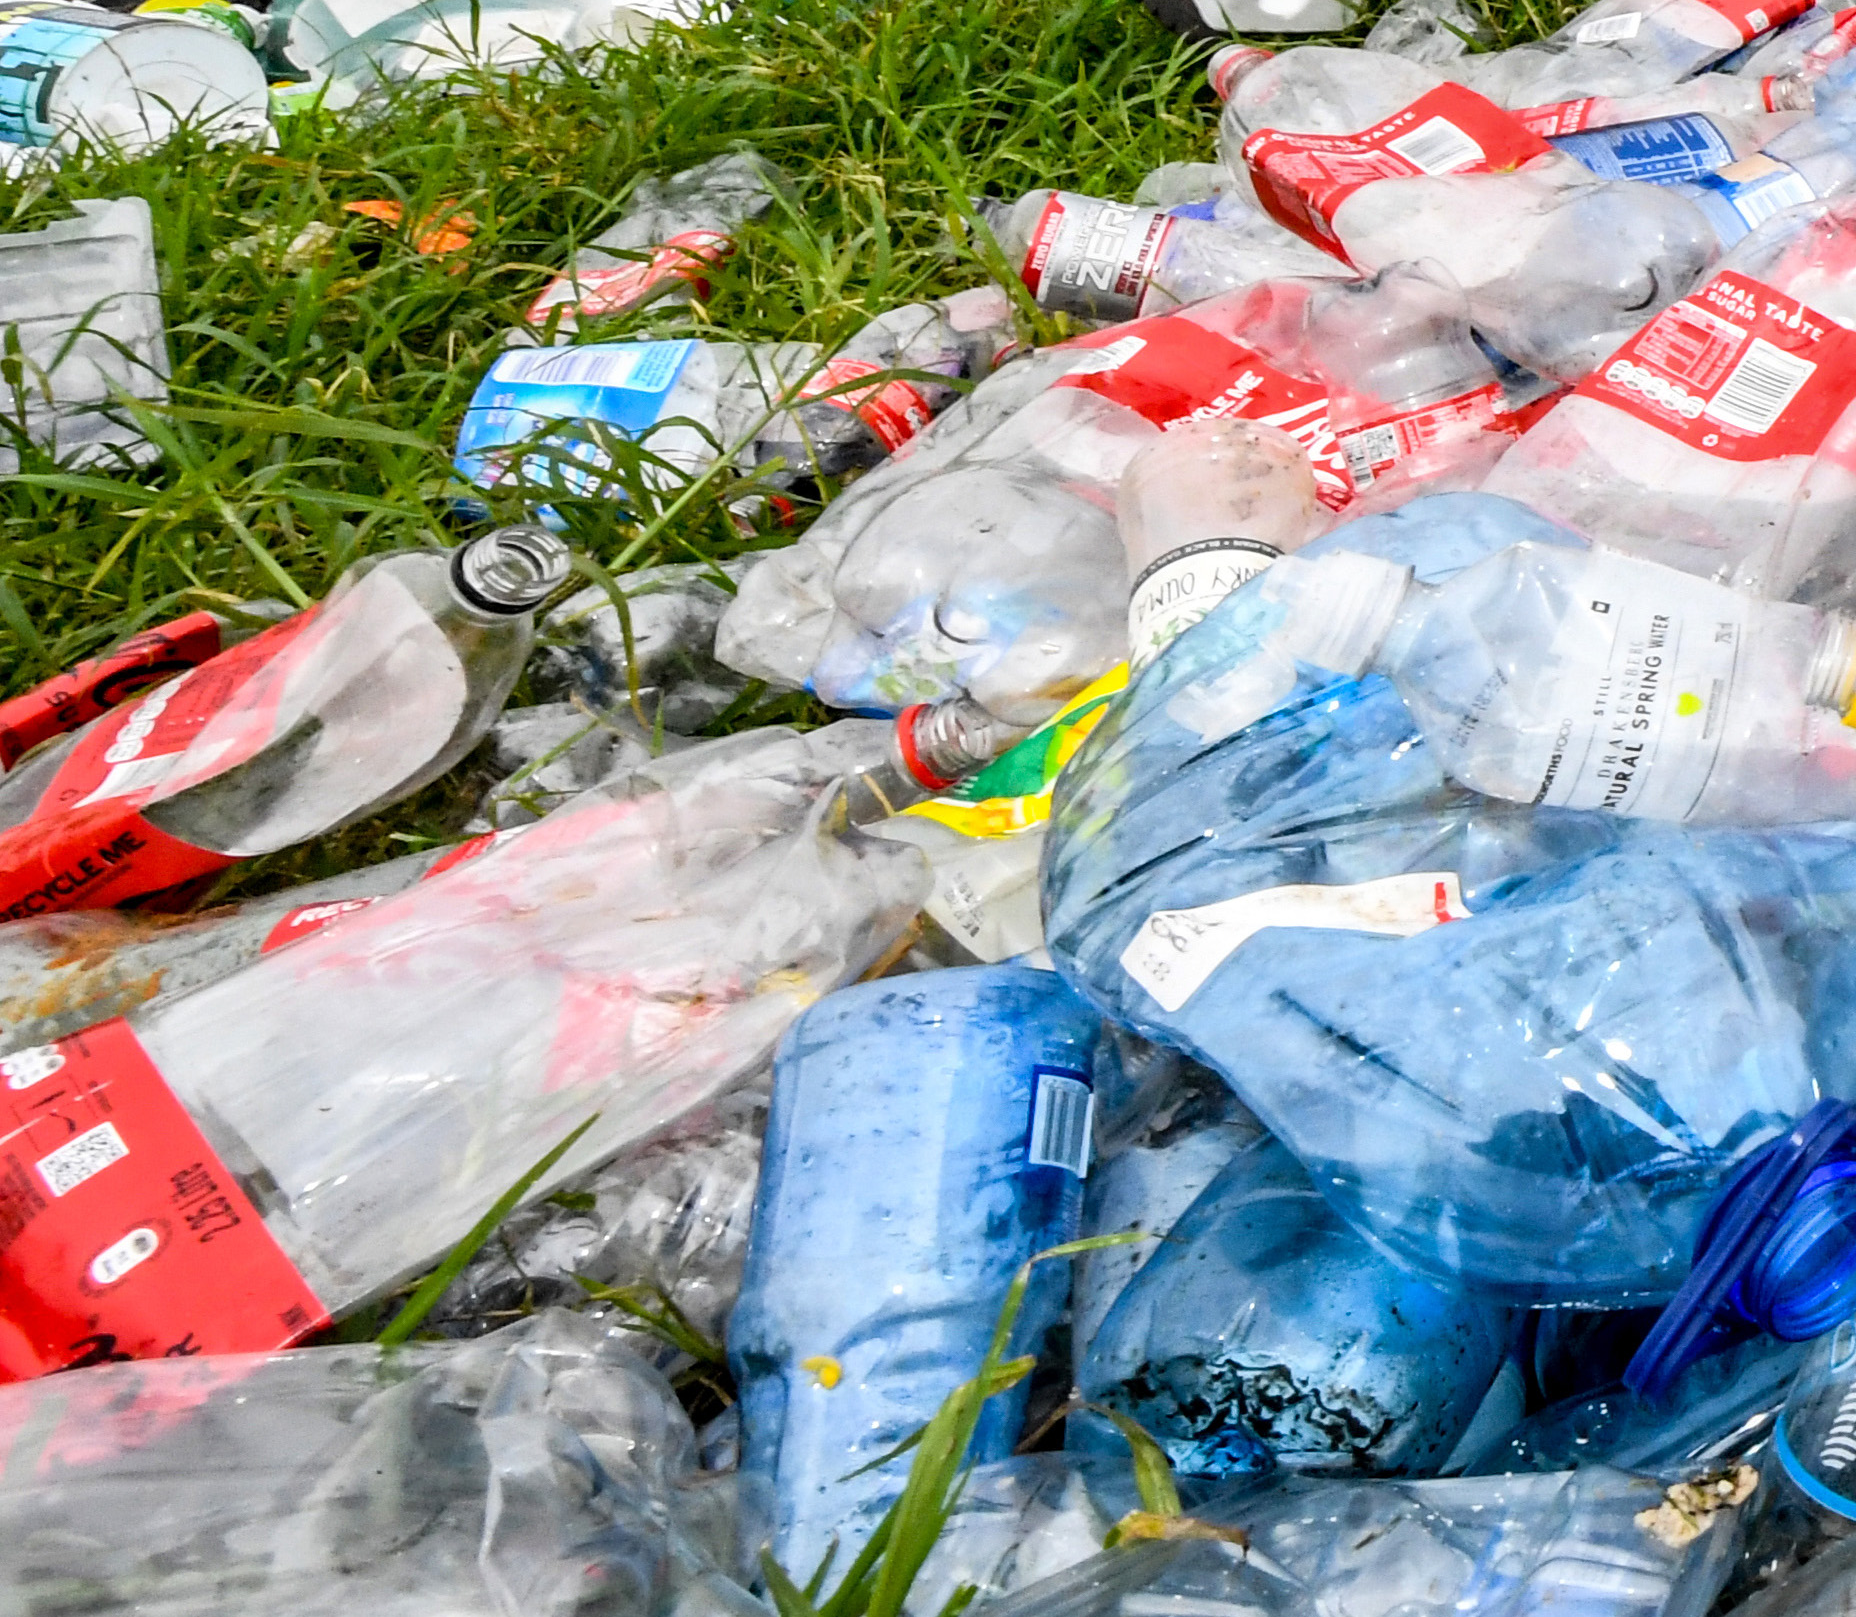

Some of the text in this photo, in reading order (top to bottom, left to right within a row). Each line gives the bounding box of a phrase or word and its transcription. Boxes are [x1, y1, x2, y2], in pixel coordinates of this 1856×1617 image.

[1707, 291, 1757, 322] SUGAR
[1593, 674, 1612, 718] STILL
[1601, 613, 1671, 811] ATURAL SPRING WATER
[104, 830, 148, 867] ME
